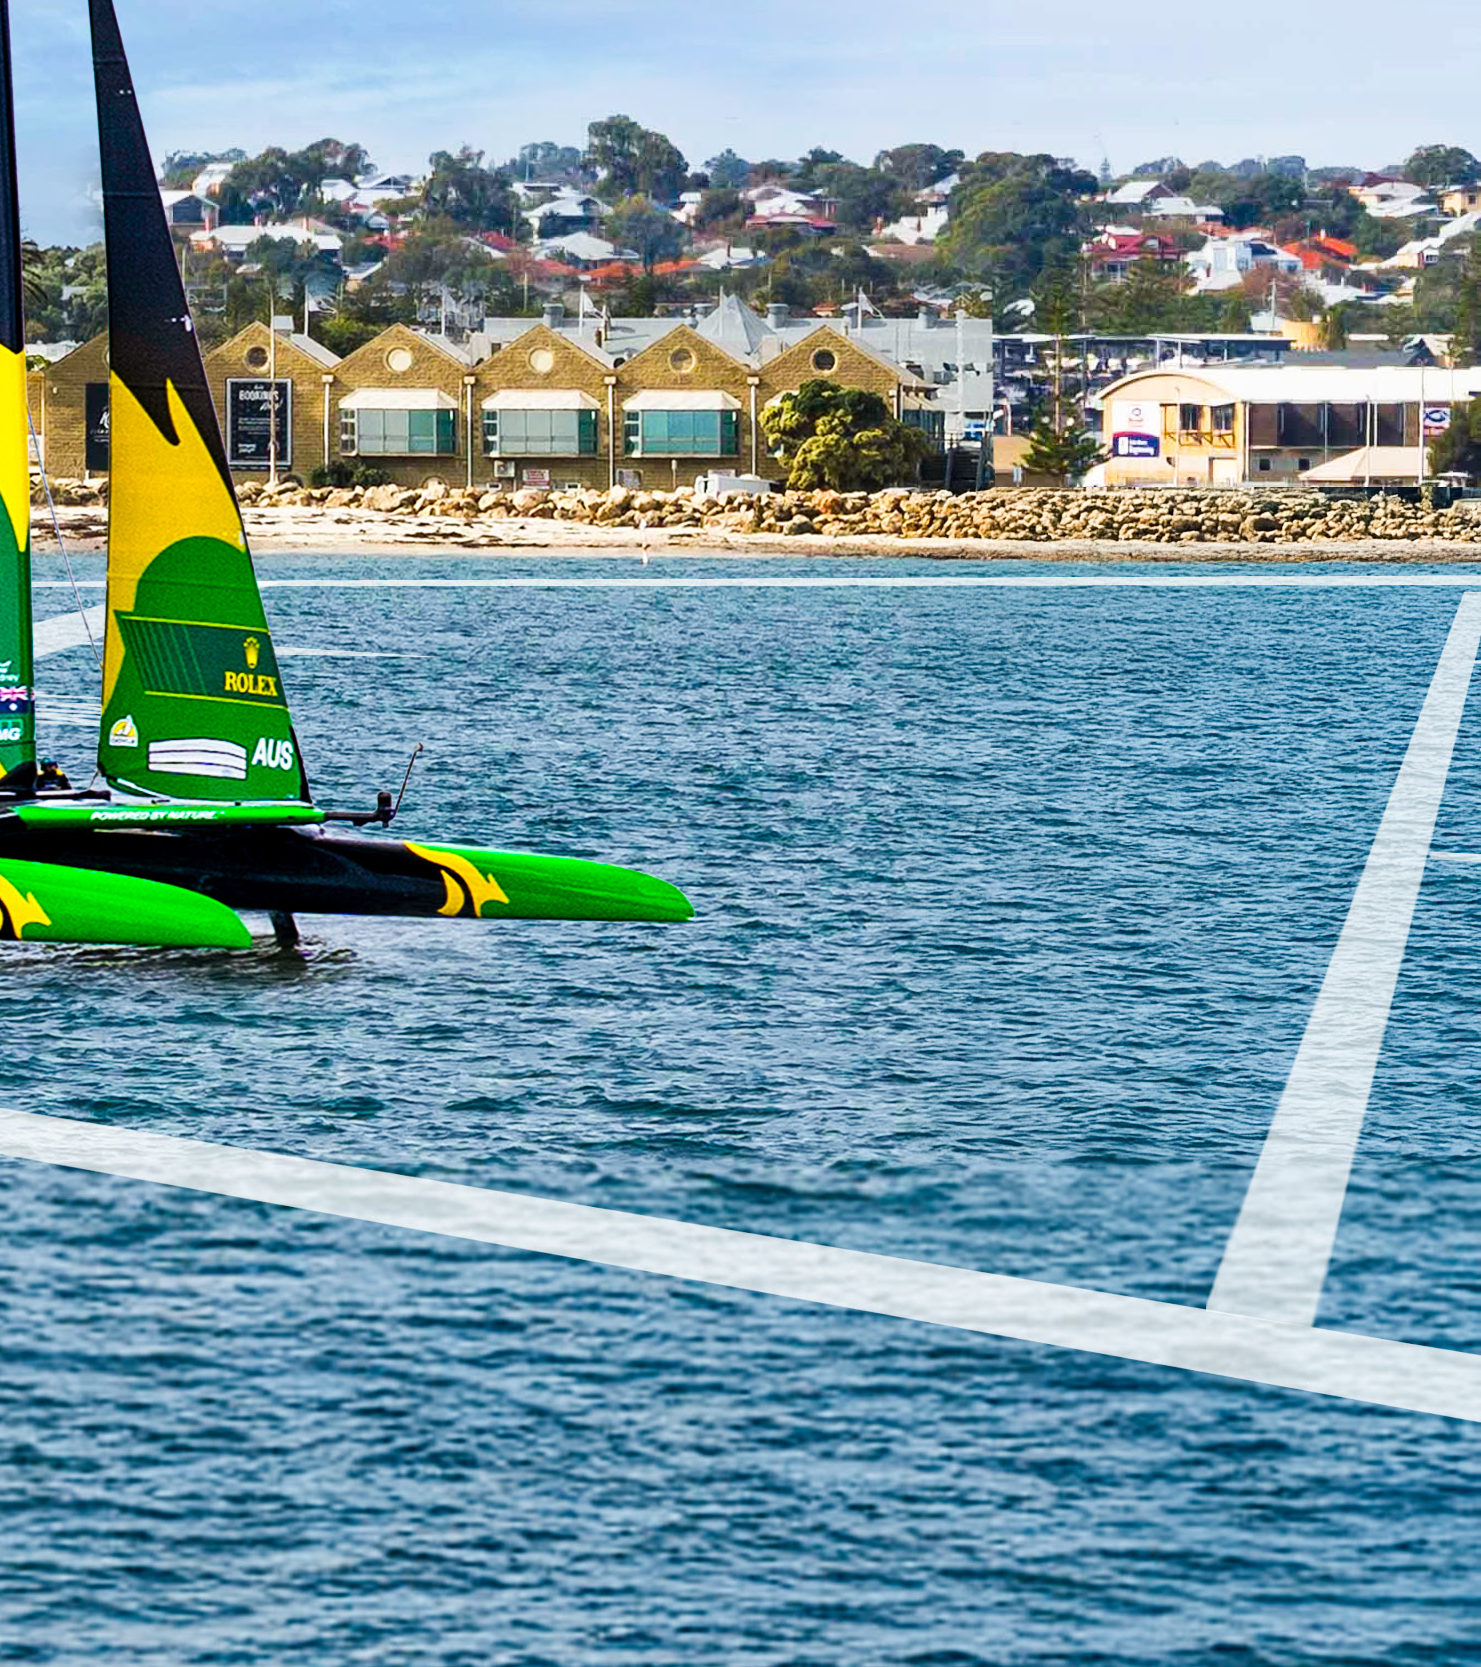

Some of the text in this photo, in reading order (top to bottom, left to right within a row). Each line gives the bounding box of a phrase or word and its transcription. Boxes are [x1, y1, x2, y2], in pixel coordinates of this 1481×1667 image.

[224, 671, 279, 697] ROLEX
[252, 737, 295, 771] AUS
[90, 810, 150, 822] POWERED
[150, 810, 166, 820] BY
